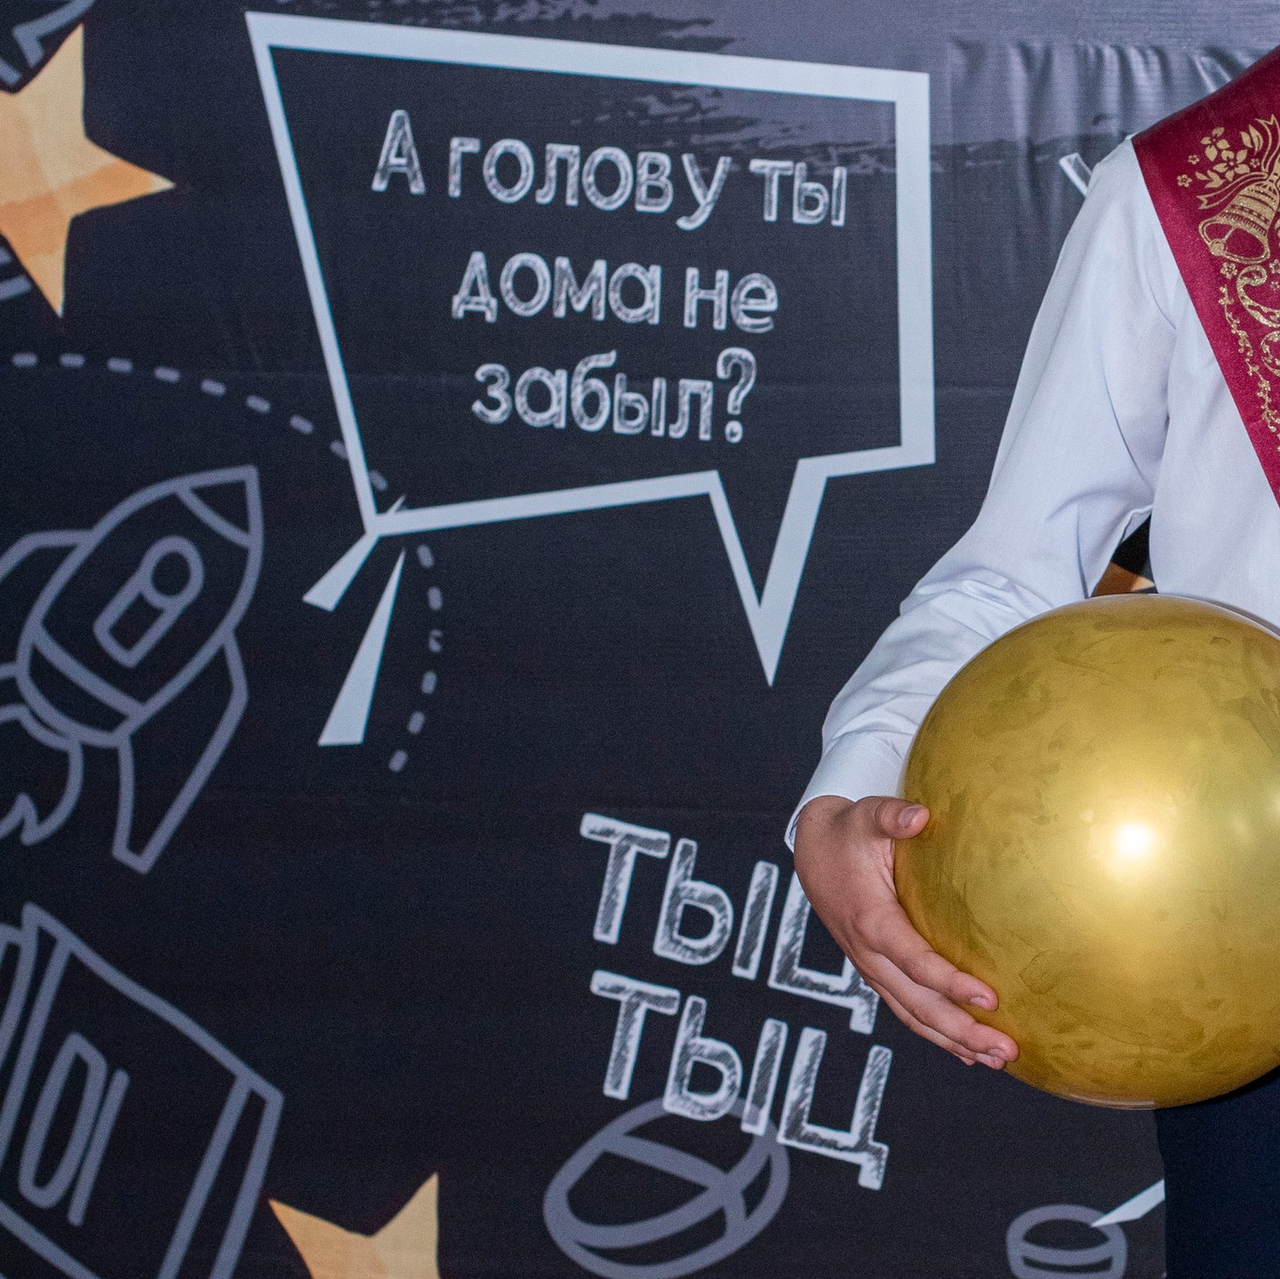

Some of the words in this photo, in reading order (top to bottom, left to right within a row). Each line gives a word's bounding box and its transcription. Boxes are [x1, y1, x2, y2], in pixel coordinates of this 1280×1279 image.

[371, 109, 426, 195] А
[447, 136, 732, 230] голову
[749, 159, 848, 226] ты
[451, 251, 662, 324] дома
[683, 266, 779, 334] не
[471, 346, 757, 443] забыл?
